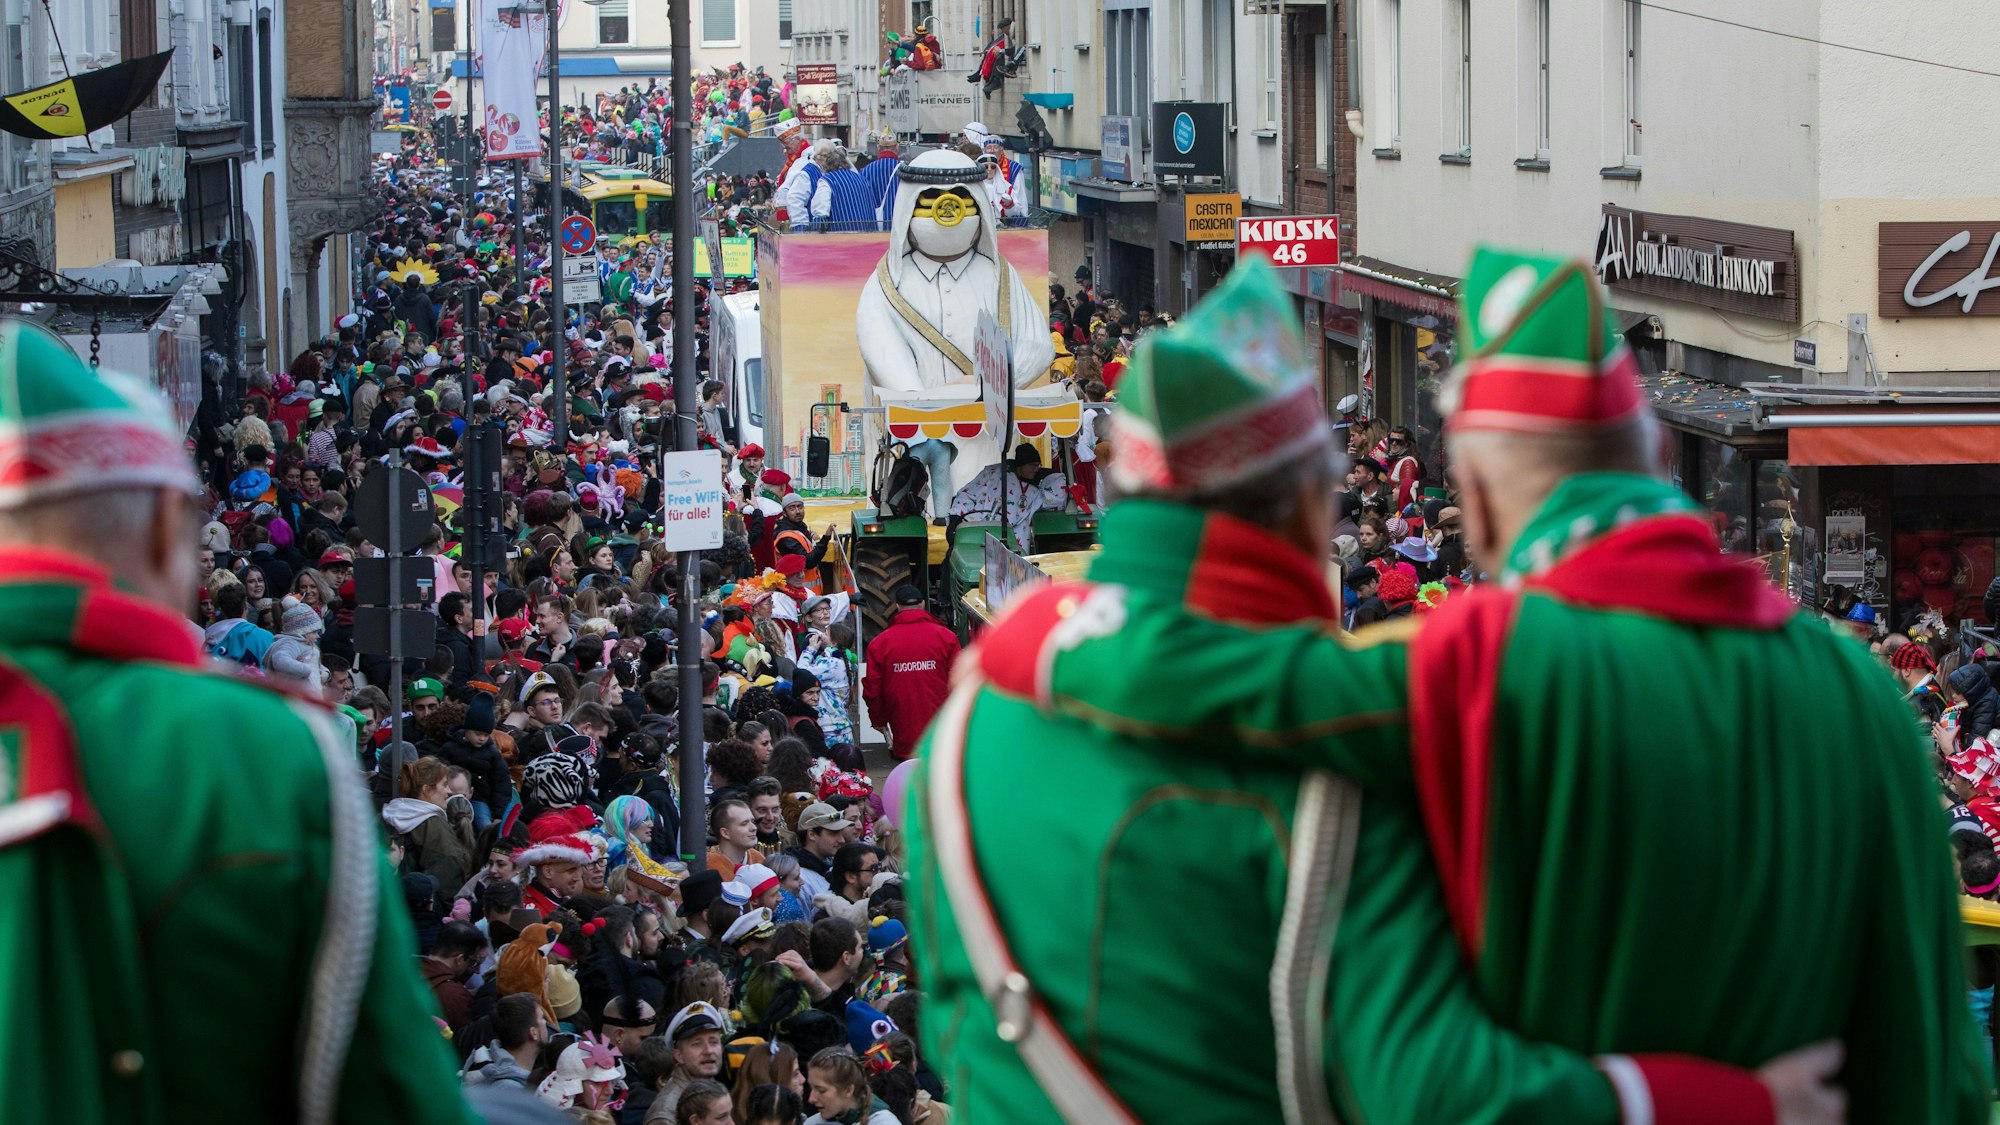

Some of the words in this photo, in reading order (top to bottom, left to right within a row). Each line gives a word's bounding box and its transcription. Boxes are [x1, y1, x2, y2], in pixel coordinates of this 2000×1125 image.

[20, 88, 66, 105] DUNLOP
[1195, 202, 1233, 216] CASITA
[1189, 217, 1235, 231] MEXICAN
[1240, 218, 1337, 242] KIOSK
[1272, 243, 1307, 264] 46
[1635, 230, 1714, 287] SÜDLÄNDISCHE
[1714, 243, 1775, 296] FEINKOST
[668, 493, 692, 505] Free
[695, 490, 719, 504] WiFi
[668, 509, 684, 521] für
[686, 507, 711, 520] alle!
[892, 659, 937, 673] ZUGORDNER
[1951, 806, 1972, 819] 12
